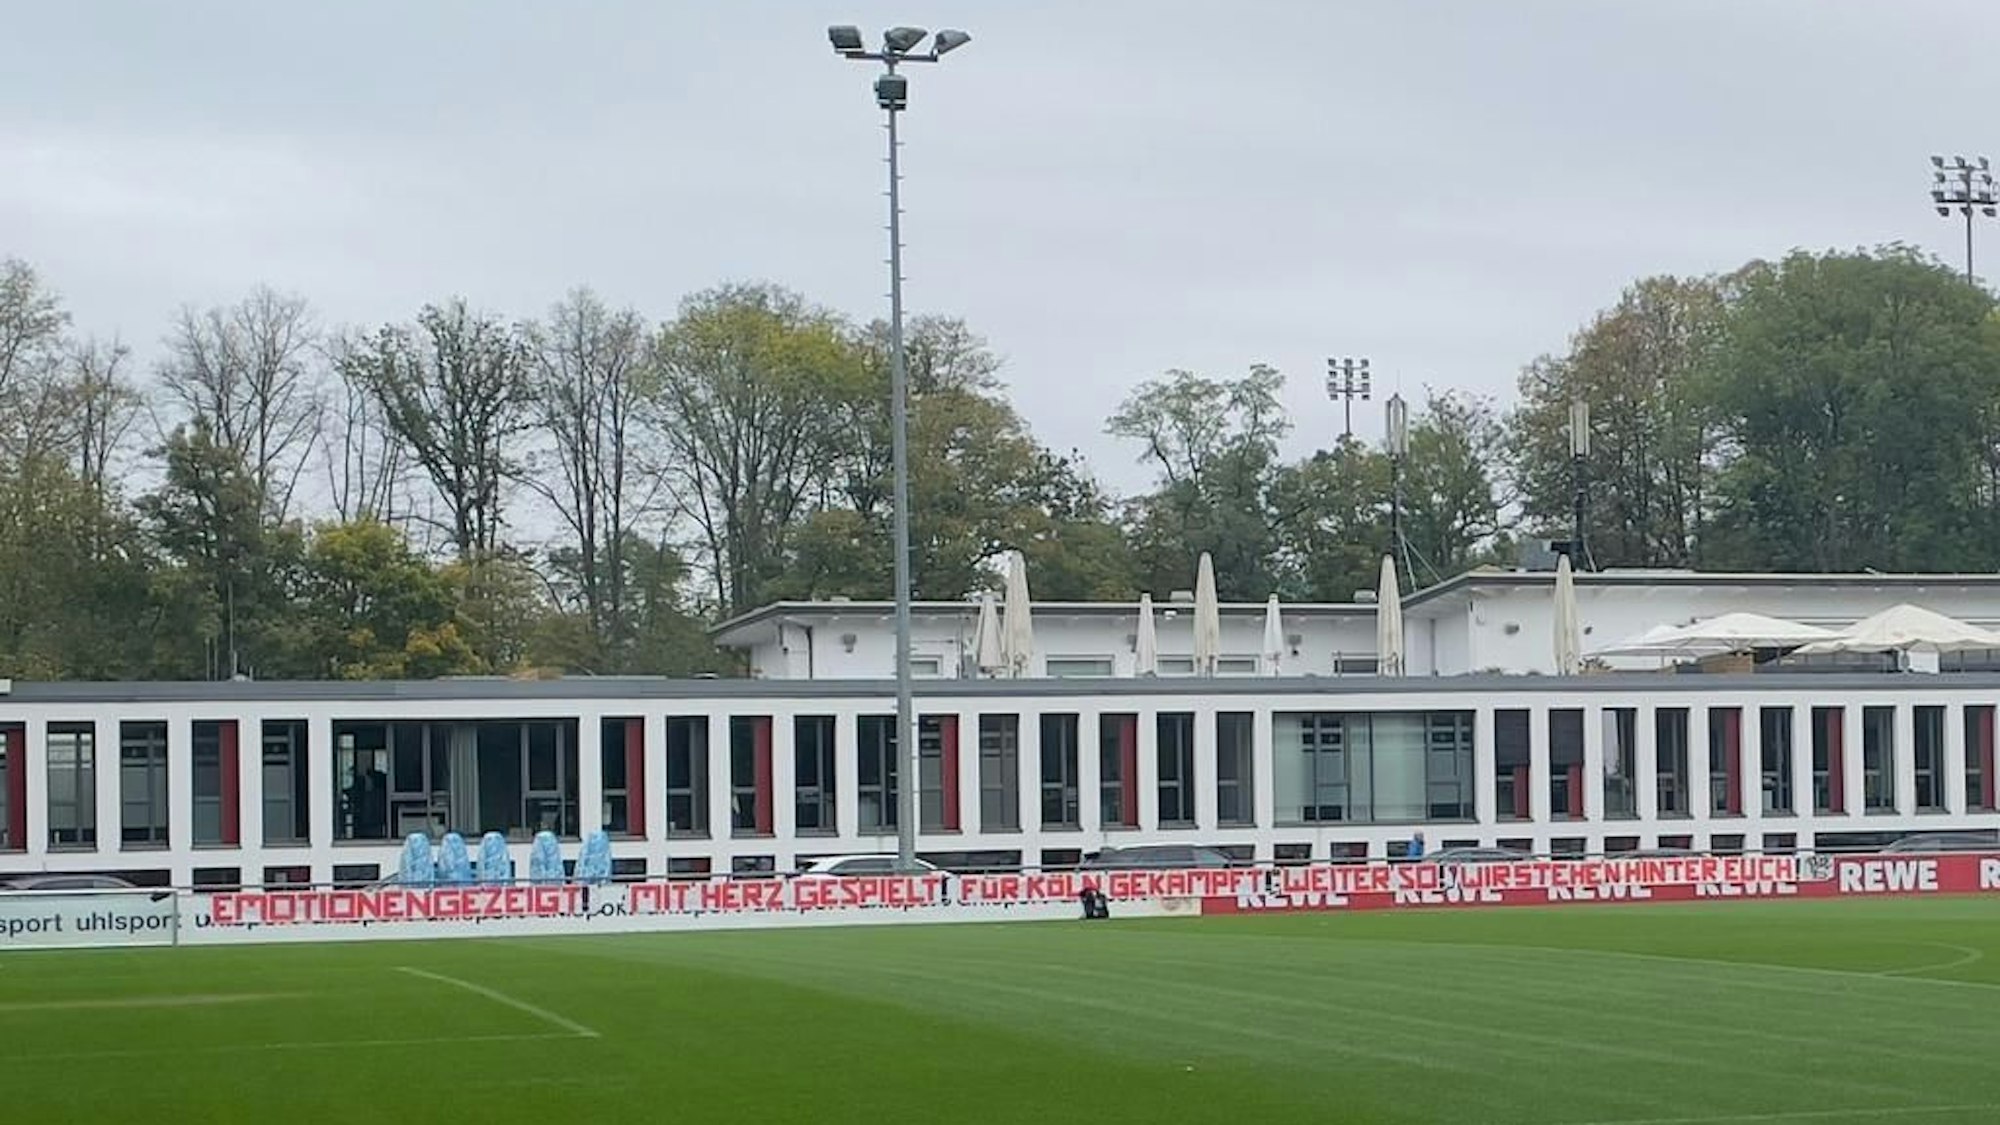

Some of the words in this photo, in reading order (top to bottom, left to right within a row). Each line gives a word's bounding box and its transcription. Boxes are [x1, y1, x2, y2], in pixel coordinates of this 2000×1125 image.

[629, 884, 690, 914] MIT
[701, 881, 784, 909] HERZ
[1283, 866, 1390, 892] WEITER
[1839, 860, 1938, 892] REWE
